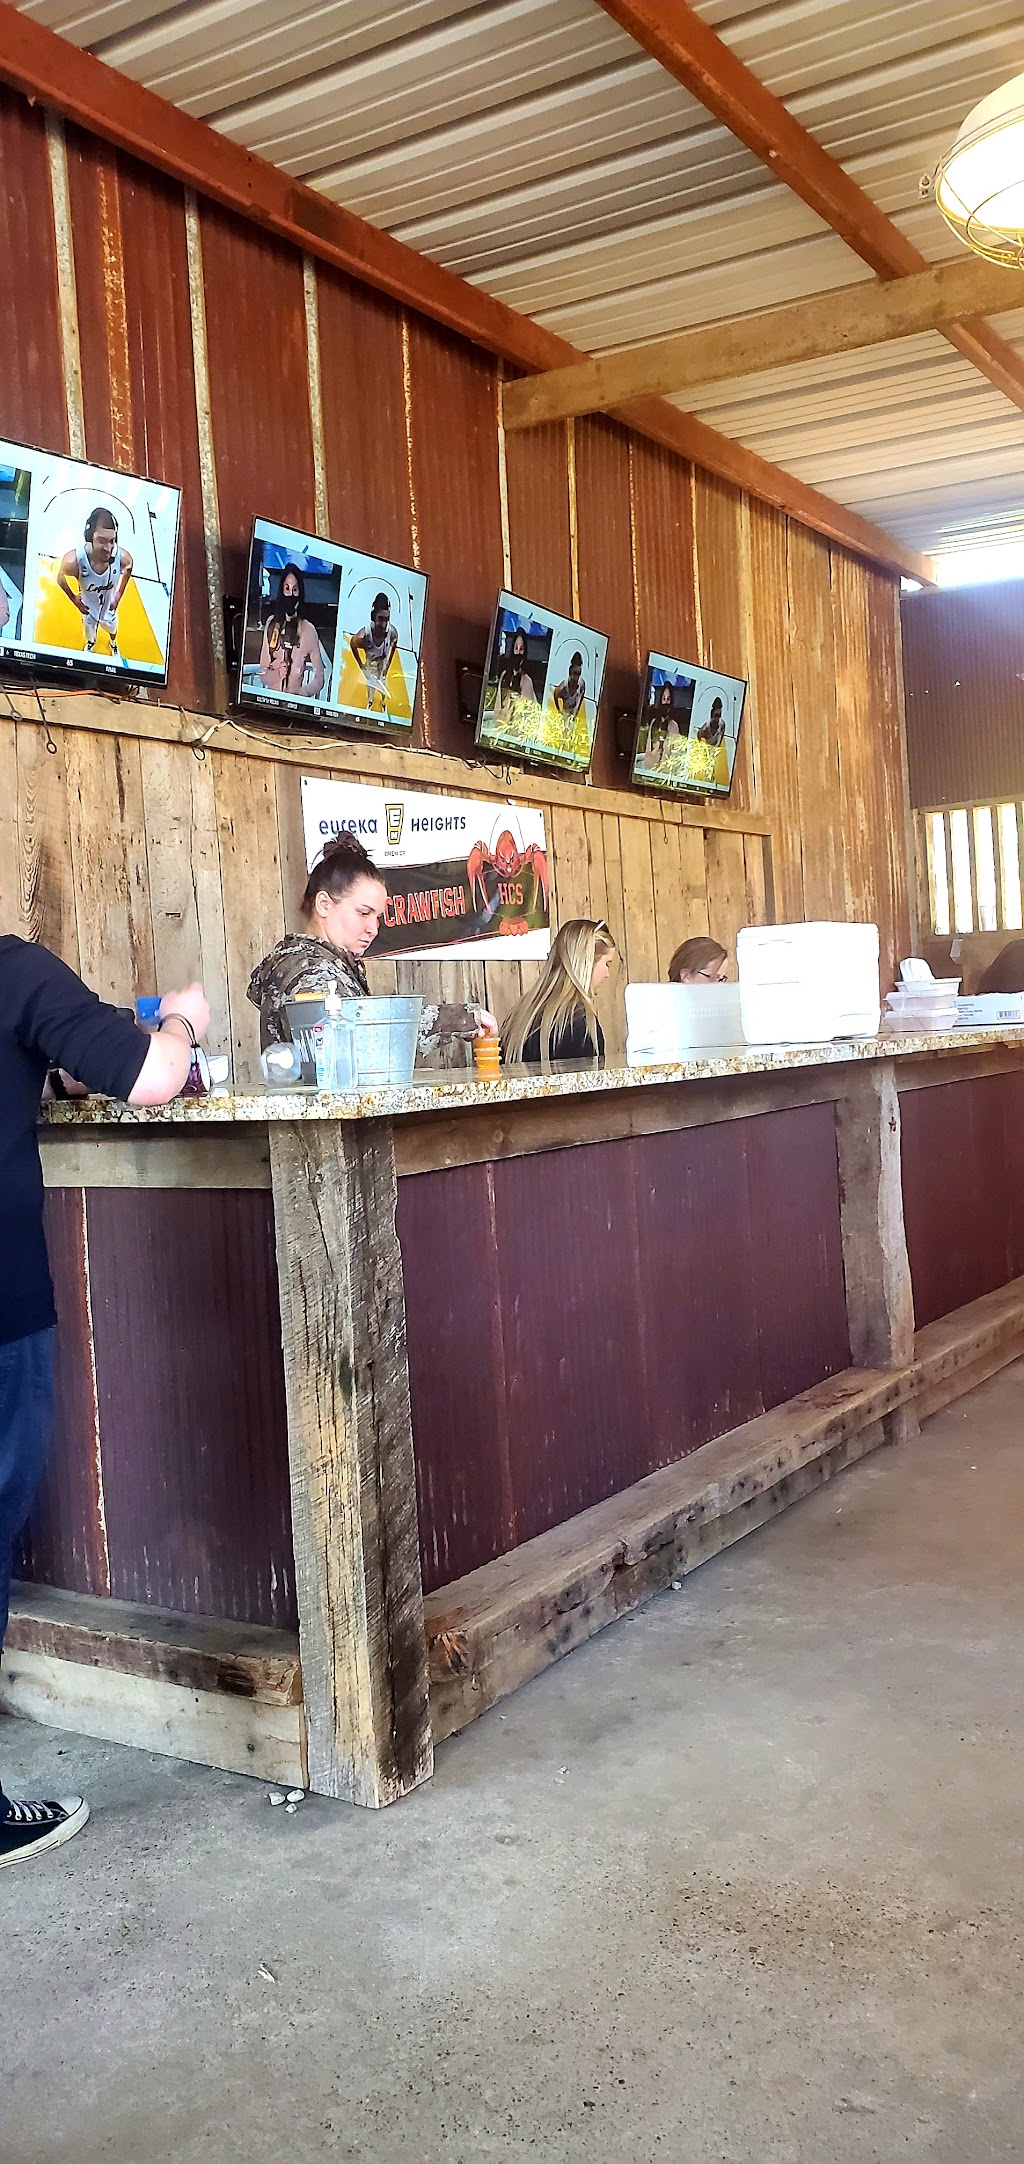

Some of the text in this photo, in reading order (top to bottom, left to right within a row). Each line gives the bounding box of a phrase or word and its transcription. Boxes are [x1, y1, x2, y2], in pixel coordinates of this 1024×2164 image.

[318, 818, 378, 835] eureka
[384, 885, 467, 927] CRAWFISH
[498, 882, 525, 906] HCS
